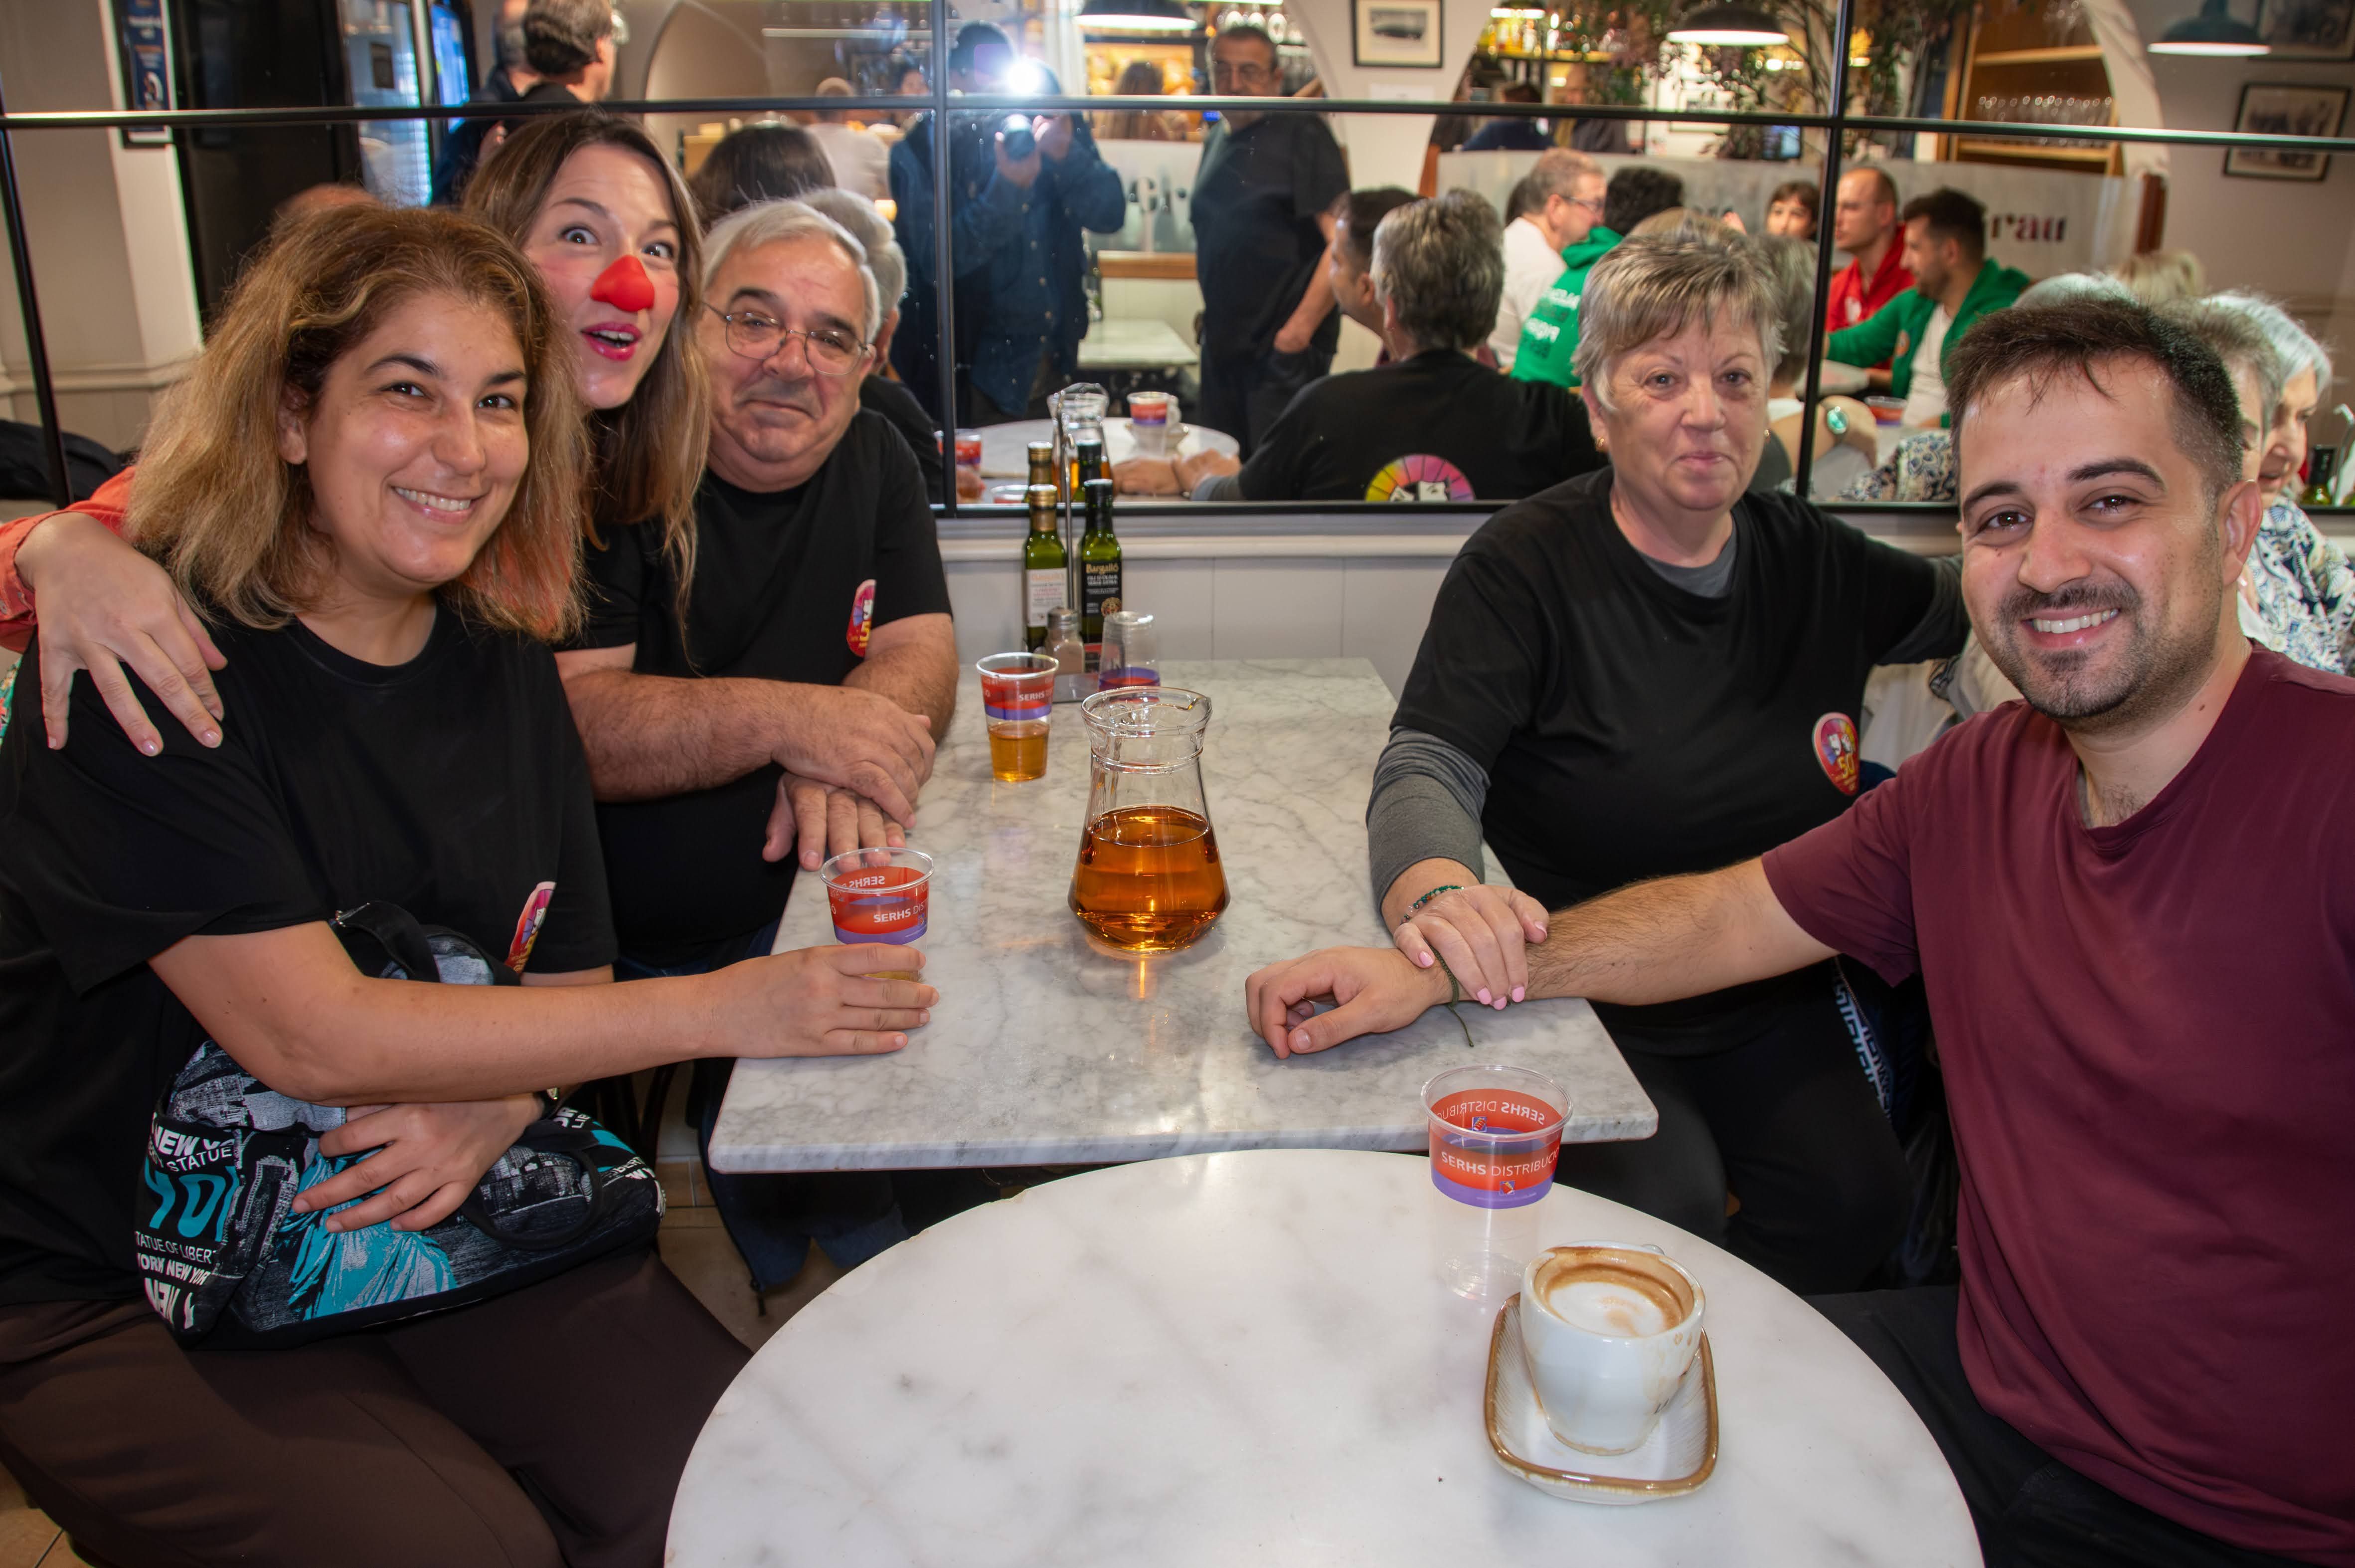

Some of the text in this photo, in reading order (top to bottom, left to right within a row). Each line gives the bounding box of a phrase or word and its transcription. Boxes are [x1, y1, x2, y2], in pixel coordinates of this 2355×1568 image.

[1019, 690, 1045, 701] SERHS
[873, 908, 911, 923] SERHS
[166, 1147, 233, 1172] STATUE
[1441, 1152, 1486, 1175] SERHS
[179, 1244, 217, 1264] LIBER
[166, 1259, 193, 1281] NEW
